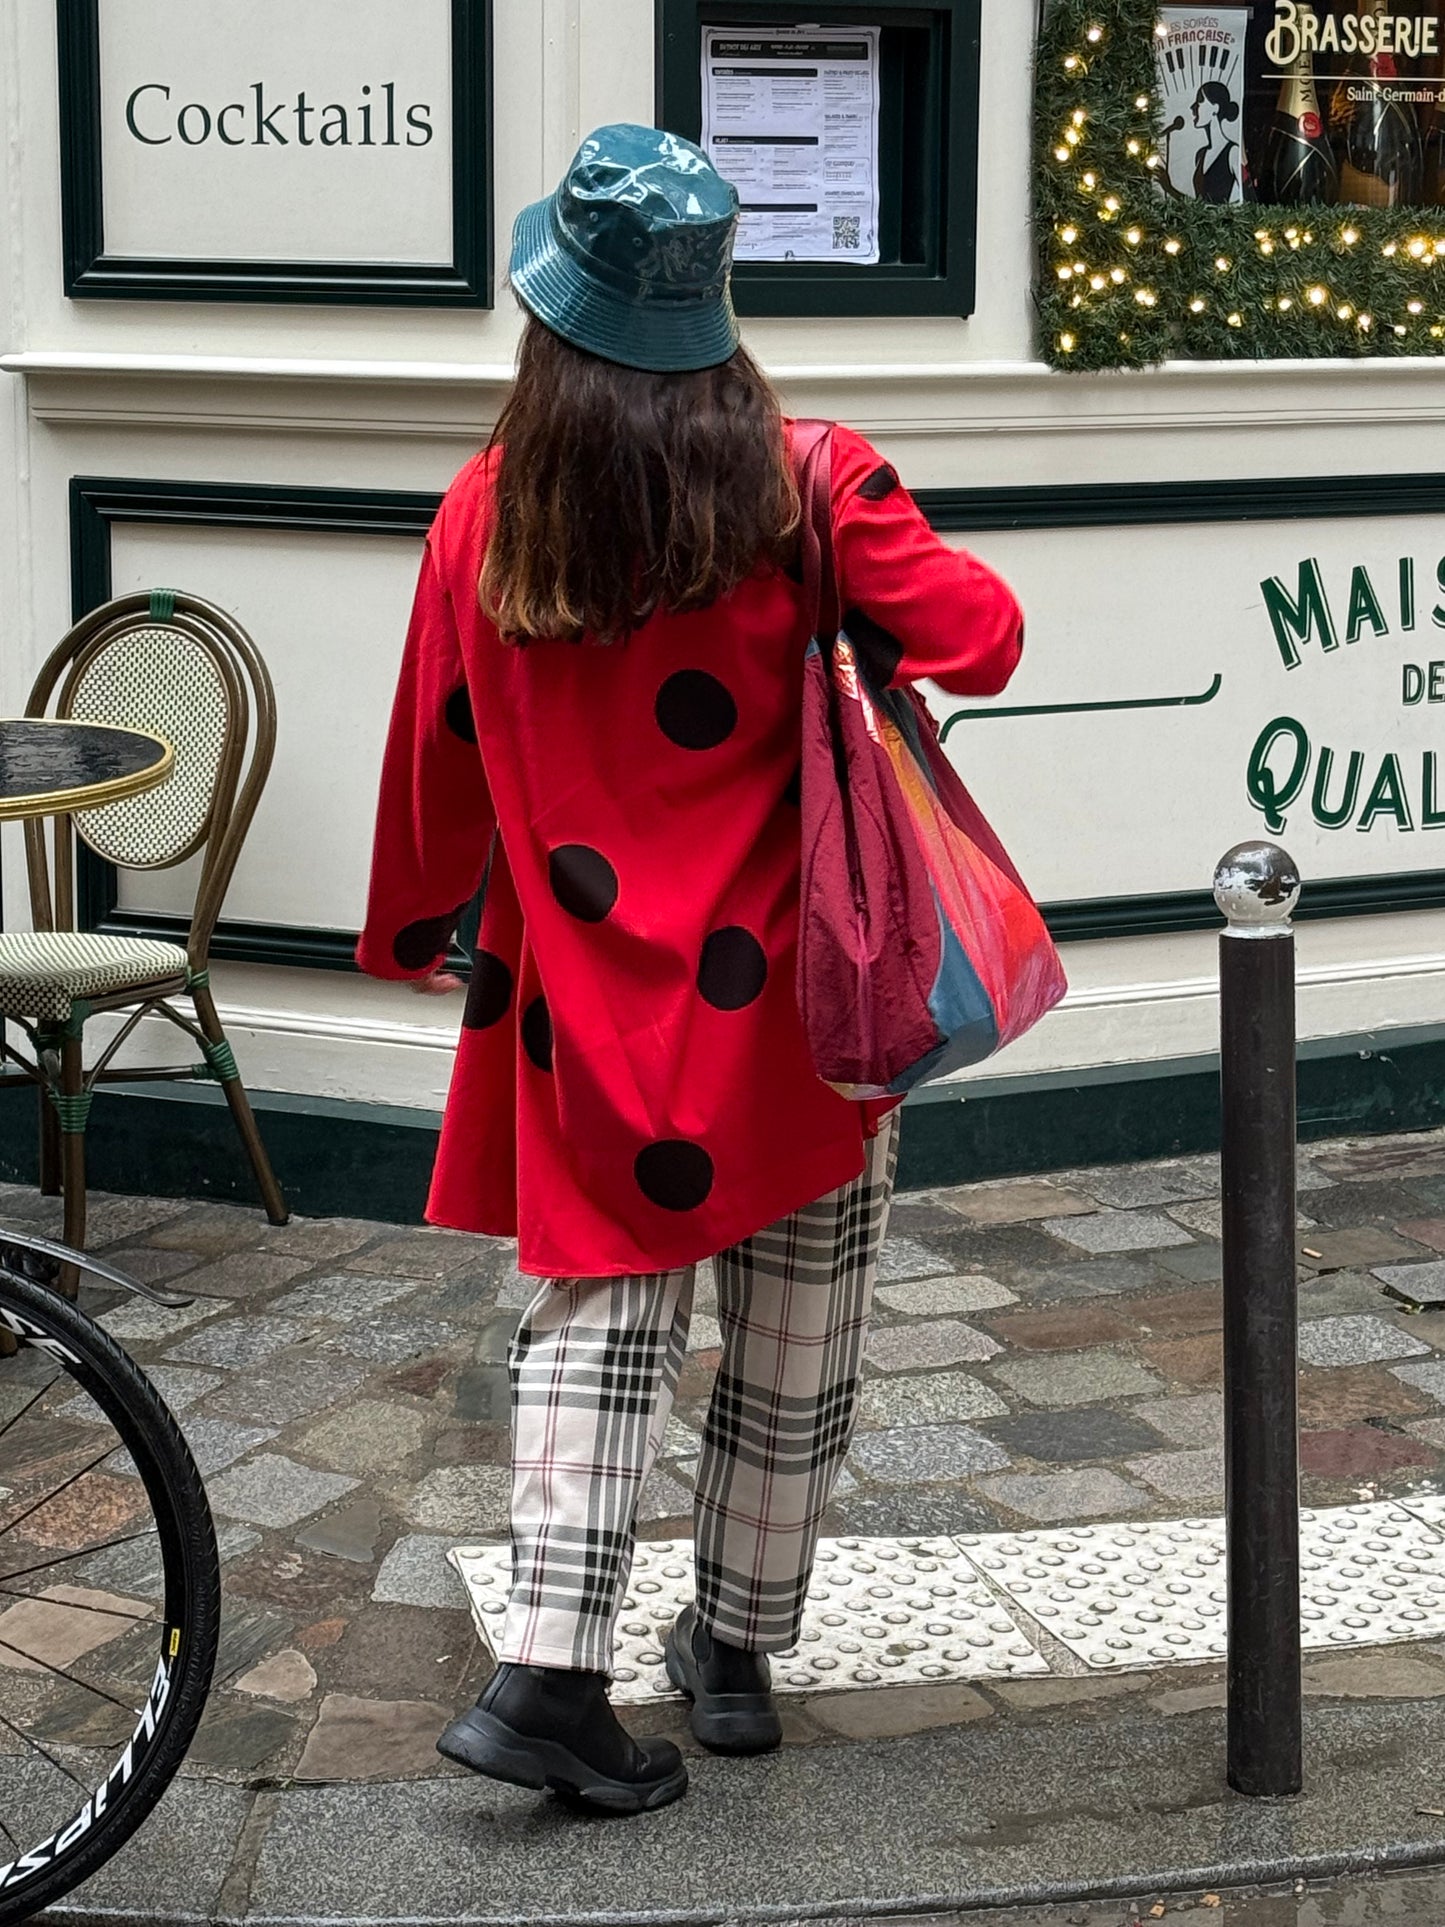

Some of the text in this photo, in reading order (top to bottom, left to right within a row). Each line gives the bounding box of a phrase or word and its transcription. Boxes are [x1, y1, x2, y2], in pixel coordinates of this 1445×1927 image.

[1265, 0, 1439, 65] BRASSERIE
[126, 81, 434, 146] Cocktails
[1402, 660, 1445, 706] DE
[1247, 716, 1445, 836] QUAL
